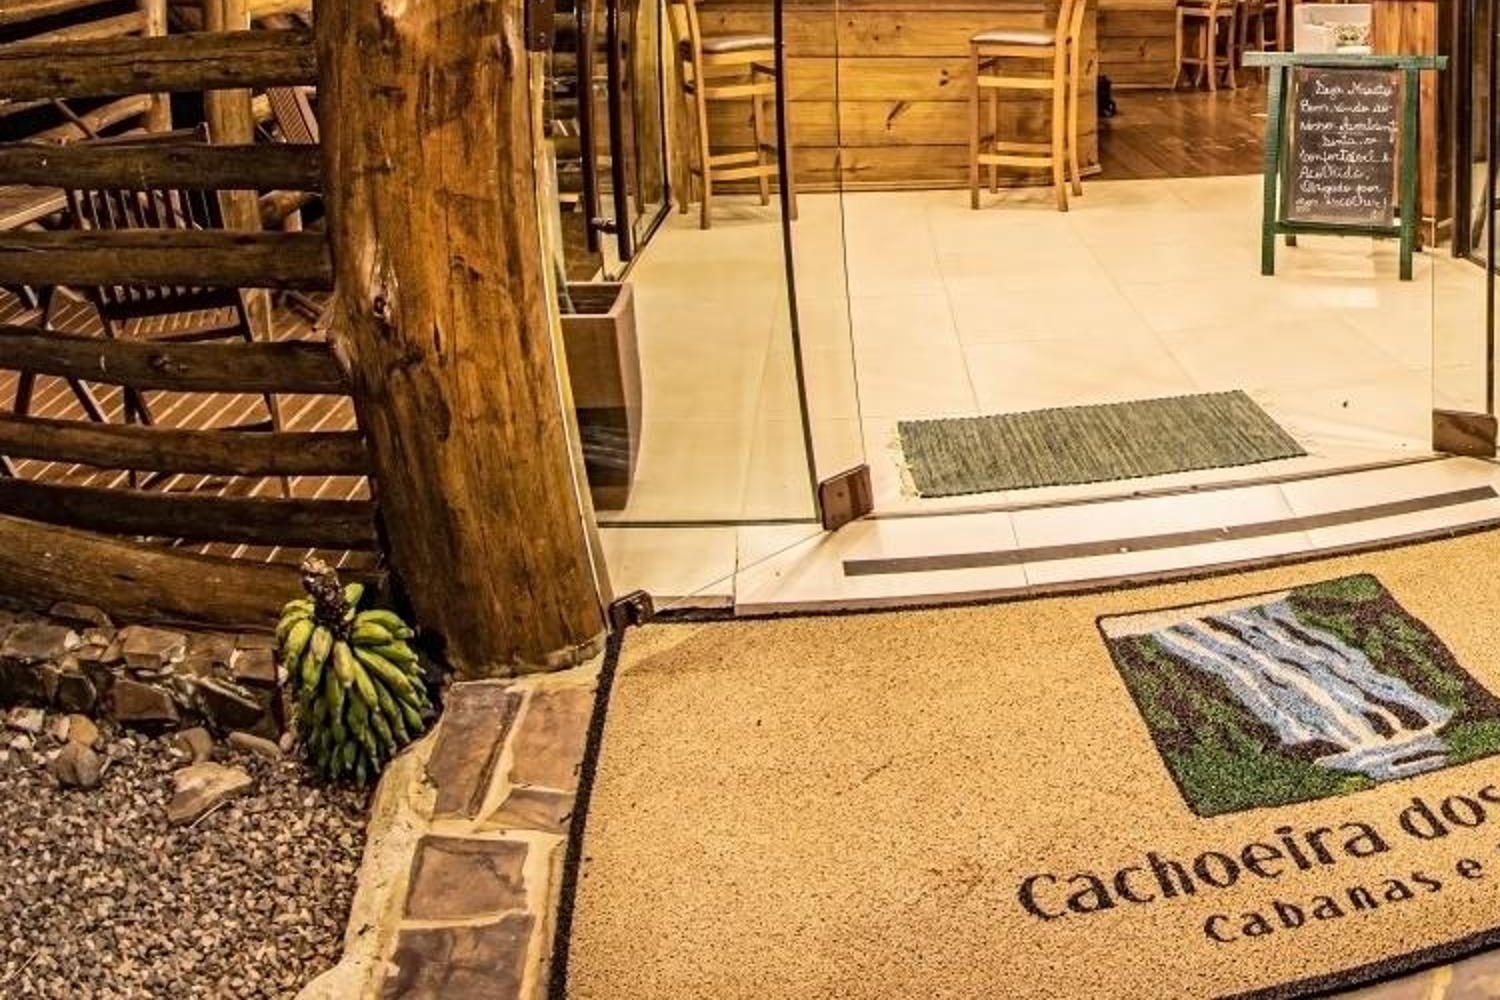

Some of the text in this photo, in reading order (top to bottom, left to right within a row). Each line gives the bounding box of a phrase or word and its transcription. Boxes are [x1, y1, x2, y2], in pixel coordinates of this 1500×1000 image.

[1016, 822, 1391, 922] Cachoeira
[1203, 867, 1445, 945] Cabanas
[1455, 855, 1485, 882] e
